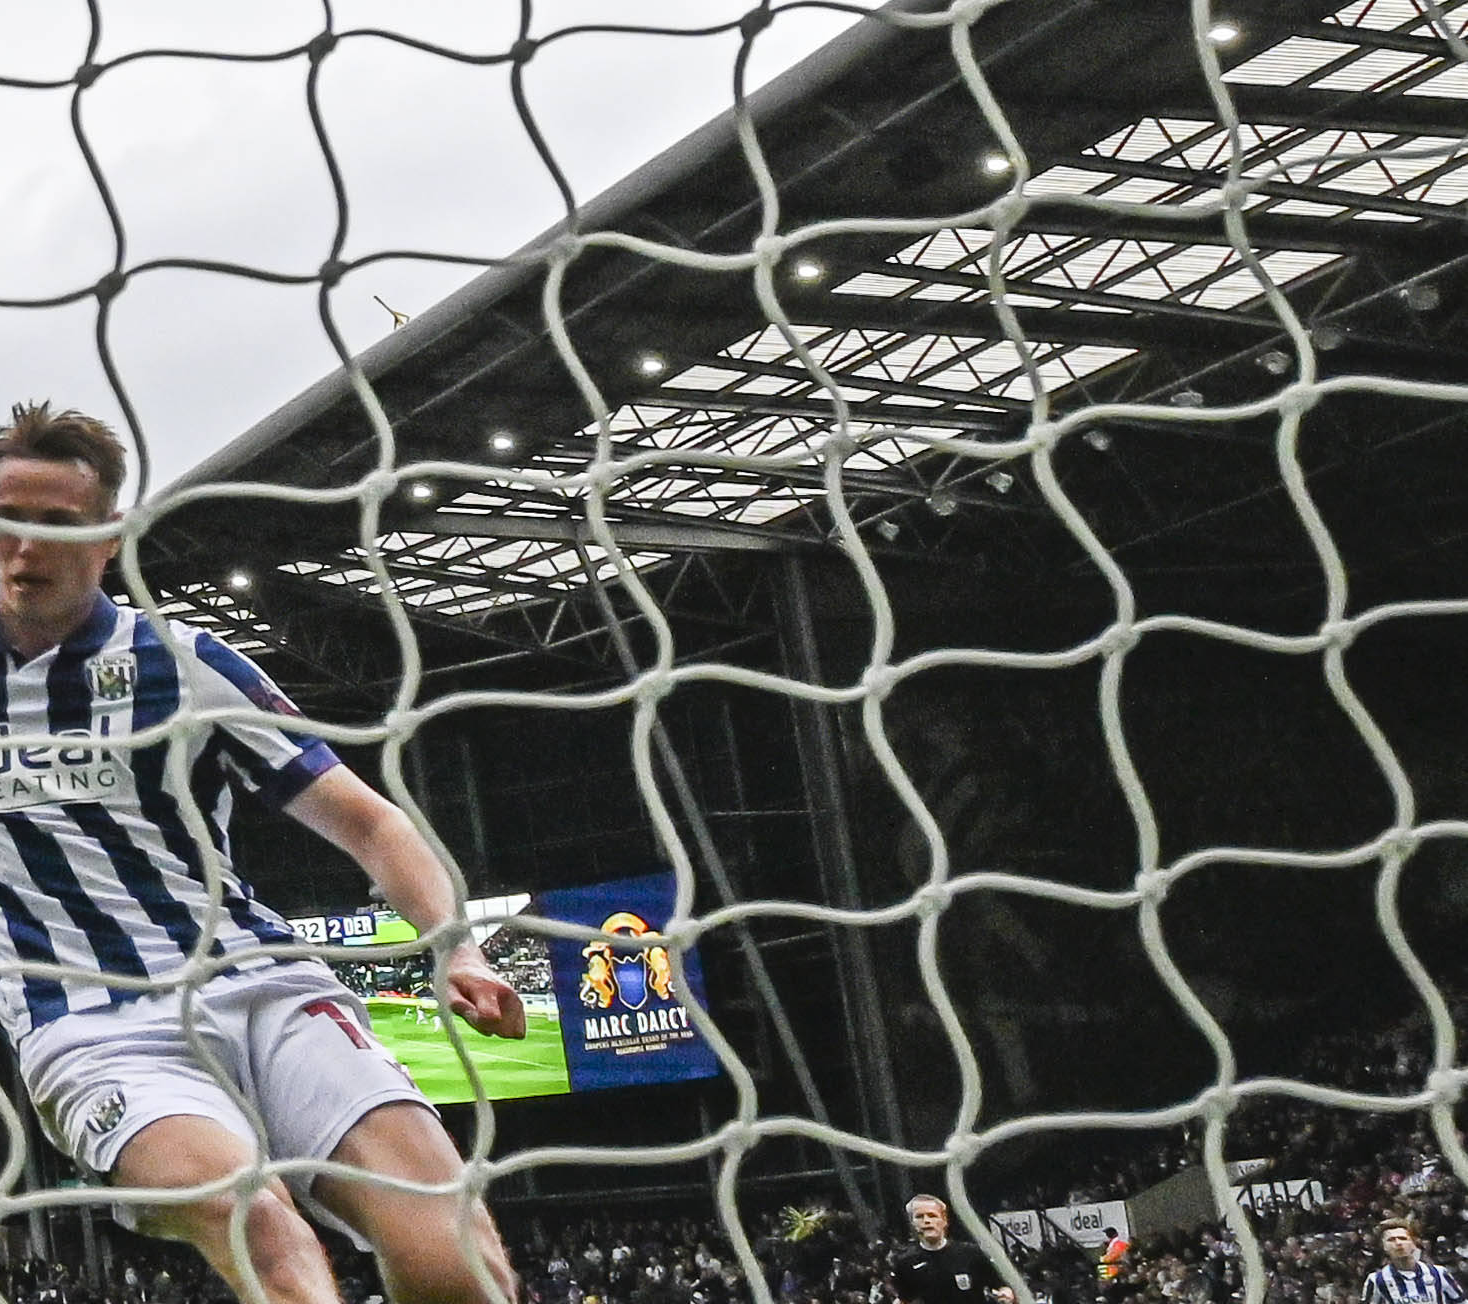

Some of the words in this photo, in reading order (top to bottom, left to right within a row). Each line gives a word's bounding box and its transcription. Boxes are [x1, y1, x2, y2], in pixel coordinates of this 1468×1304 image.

[328, 918, 342, 938] 2
[343, 915, 374, 936] DER
[584, 1014, 632, 1040] MARC
[636, 1007, 689, 1034] DARCY
[1071, 1209, 1103, 1231] ideal
